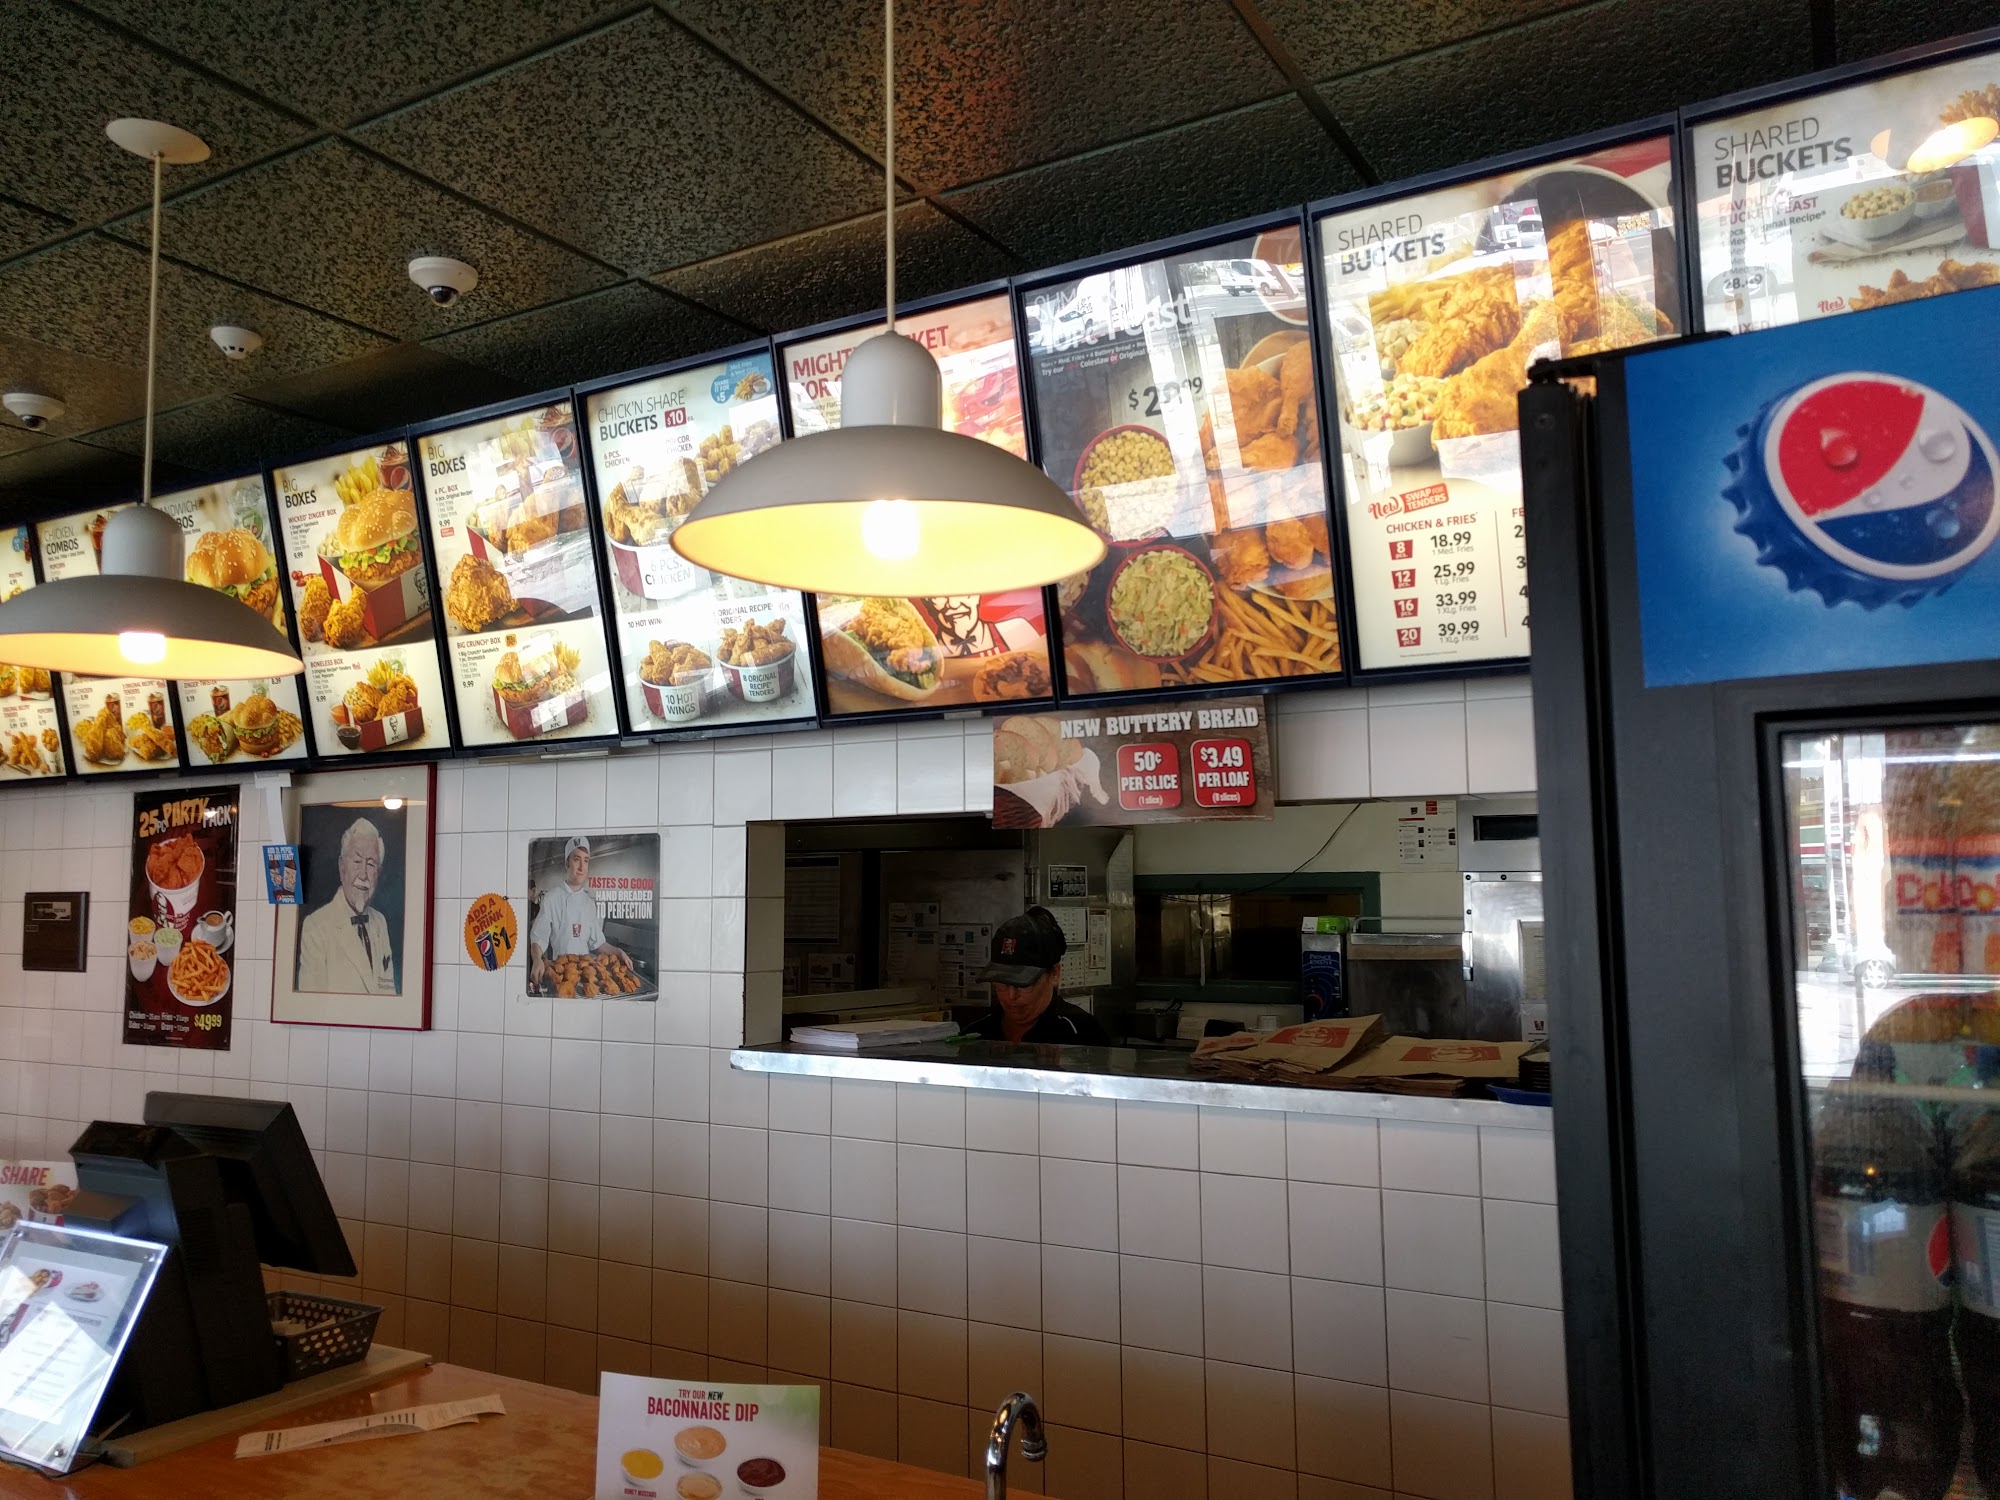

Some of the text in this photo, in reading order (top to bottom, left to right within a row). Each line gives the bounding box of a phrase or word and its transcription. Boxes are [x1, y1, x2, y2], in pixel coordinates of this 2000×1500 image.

[1714, 117, 1820, 161] SHARED
[1716, 137, 1853, 189] BUCKETS
[1338, 214, 1423, 251] SHARED
[1341, 233, 1446, 275] BUCKETS
[1817, 297, 1845, 312] New
[793, 347, 855, 380] MIGHT
[904, 325, 949, 350] KET
[1080, 358, 1109, 368] Coleslaw
[1119, 348, 1146, 360] Original
[646, 389, 686, 413] SHARE
[600, 414, 658, 442] BUCKETS
[666, 411, 685, 426] $10
[428, 444, 445, 460] BIG
[608, 450, 621, 459] PCS.
[430, 456, 466, 477] BOXES
[604, 457, 630, 468] CHICKEN
[283, 478, 297, 493] BIG
[447, 484, 458, 493] BOX
[285, 489, 317, 508] BOXES
[1405, 486, 1444, 502] SWAP FOR
[1407, 493, 1447, 511] TENDERS
[1368, 496, 1403, 520] New
[439, 519, 451, 527] 9.99
[1386, 519, 1432, 534] CHICKEN
[1435, 518, 1444, 527] &
[44, 526, 75, 542] CHICKEN
[1430, 531, 1472, 549] 18.99
[46, 538, 79, 555] COMBOS
[1396, 542, 1406, 554] 8
[1457, 545, 1474, 553] Fries
[294, 551, 303, 559] 9.99
[651, 556, 683, 572] 6 PCS.
[1433, 561, 1475, 579] 25.99
[1395, 570, 1411, 583] 12
[1452, 575, 1470, 583] Fries
[1397, 600, 1415, 612] 16
[1436, 590, 1477, 608] 33.99
[1459, 604, 1477, 612] Fries
[636, 619, 646, 628] HOT
[648, 618, 663, 626] WIN
[1438, 620, 1480, 637] 39.99
[490, 637, 501, 645] BOX
[1400, 629, 1418, 641] 20
[1462, 633, 1480, 642] Fries
[462, 680, 474, 689] 9.99
[748, 672, 777, 682] ORIGINAL
[665, 692, 693, 704] 10 HOT
[749, 689, 775, 697] TENDERS
[667, 703, 696, 715] WINGS
[1060, 707, 1259, 739] NEW BUTTERY BREAD
[1134, 746, 1244, 772] 50¢ $3.49
[1121, 774, 1178, 791] PER SLICE
[1198, 771, 1250, 788] PER LOAF
[139, 797, 232, 838] 25 PC PARTY PACK
[588, 877, 654, 889] TASTES SO GOOD
[596, 890, 653, 901] HAND BREADED
[467, 903, 487, 926] ADD
[488, 897, 497, 909] A
[596, 901, 653, 919] TO PERFECTION
[472, 908, 504, 936] DRINK
[492, 927, 512, 950] $1
[0, 1166, 50, 1186] SHARE
[679, 1388, 724, 1401] TRY OUR NEW
[647, 1396, 759, 1422] BACONNAISE DIP
[624, 1488, 637, 1496] HONEY
